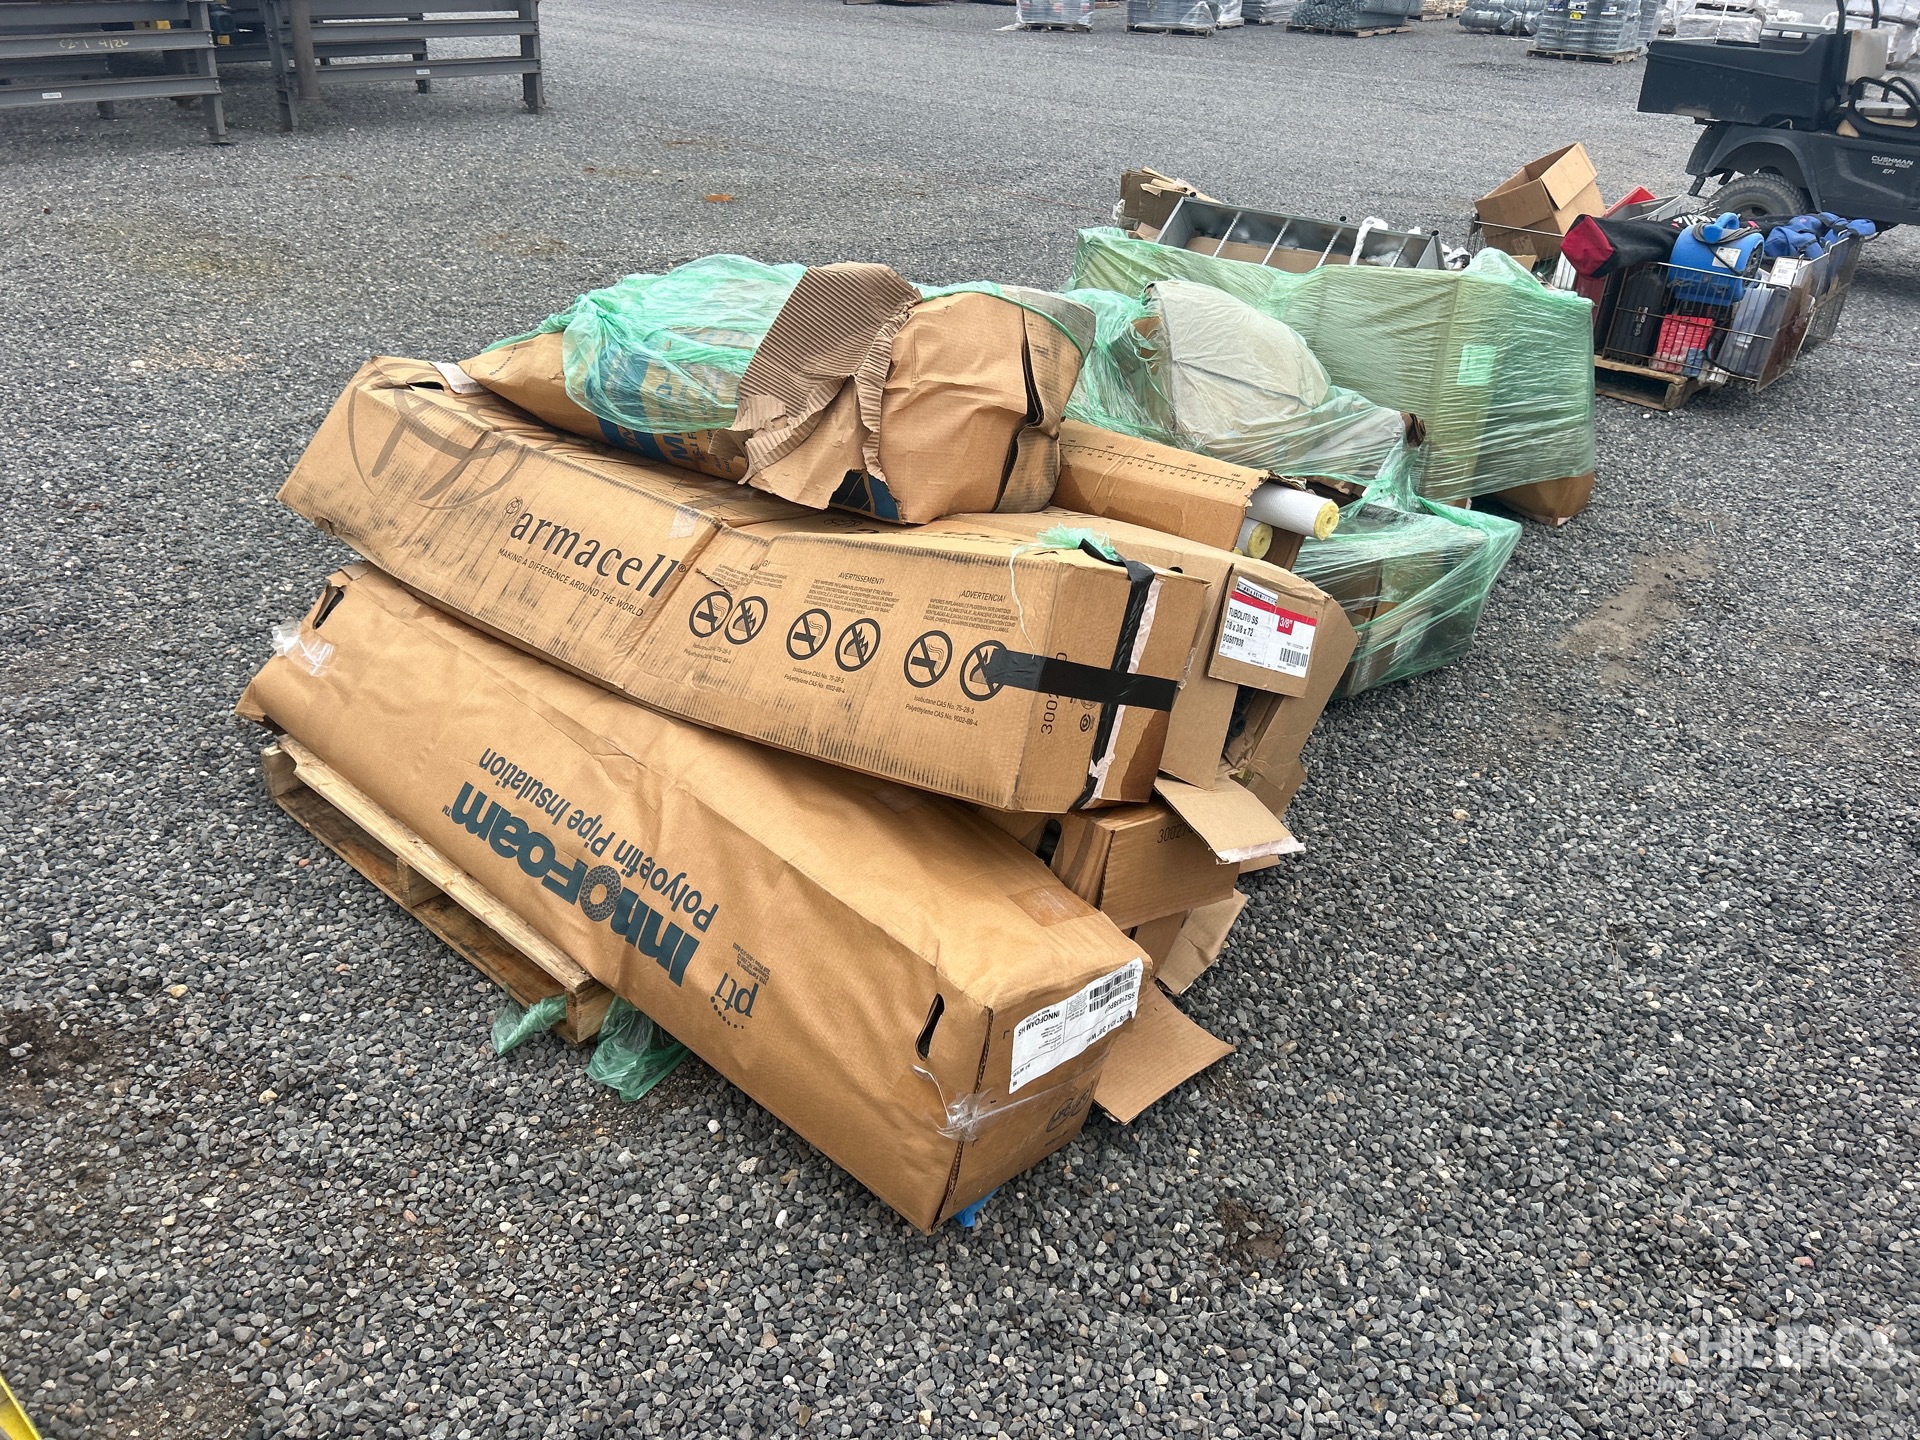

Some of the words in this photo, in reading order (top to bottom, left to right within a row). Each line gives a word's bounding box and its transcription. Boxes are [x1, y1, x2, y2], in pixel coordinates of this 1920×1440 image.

[1871, 155, 1914, 166] CUSHMAN
[498, 547, 522, 563] MAKING
[528, 559, 570, 585] DIFFERENCE
[569, 579, 600, 597] AROUND
[600, 591, 615, 605] THE
[616, 600, 644, 617] WORLD
[838, 572, 885, 585] AVERTISSEMENT!
[959, 590, 1006, 602] ¡ADVERTENCIA!
[1251, 615, 1259, 625] SS
[1279, 617, 1293, 629] 3/8"
[1247, 627, 1254, 637] 72
[914, 695, 937, 706] Isobutane
[936, 700, 947, 708] CAS
[955, 704, 975, 715] 75-28-5
[905, 703, 934, 716] Polyethylene
[934, 710, 945, 719] CAS
[953, 714, 978, 727] 9002-88-4
[478, 748, 572, 826] Insulation
[567, 809, 616, 858] Pipe
[710, 972, 759, 1019] pti
[1026, 1010, 1060, 1031] INNOFOAM
[1018, 1025, 1026, 1037] HS
